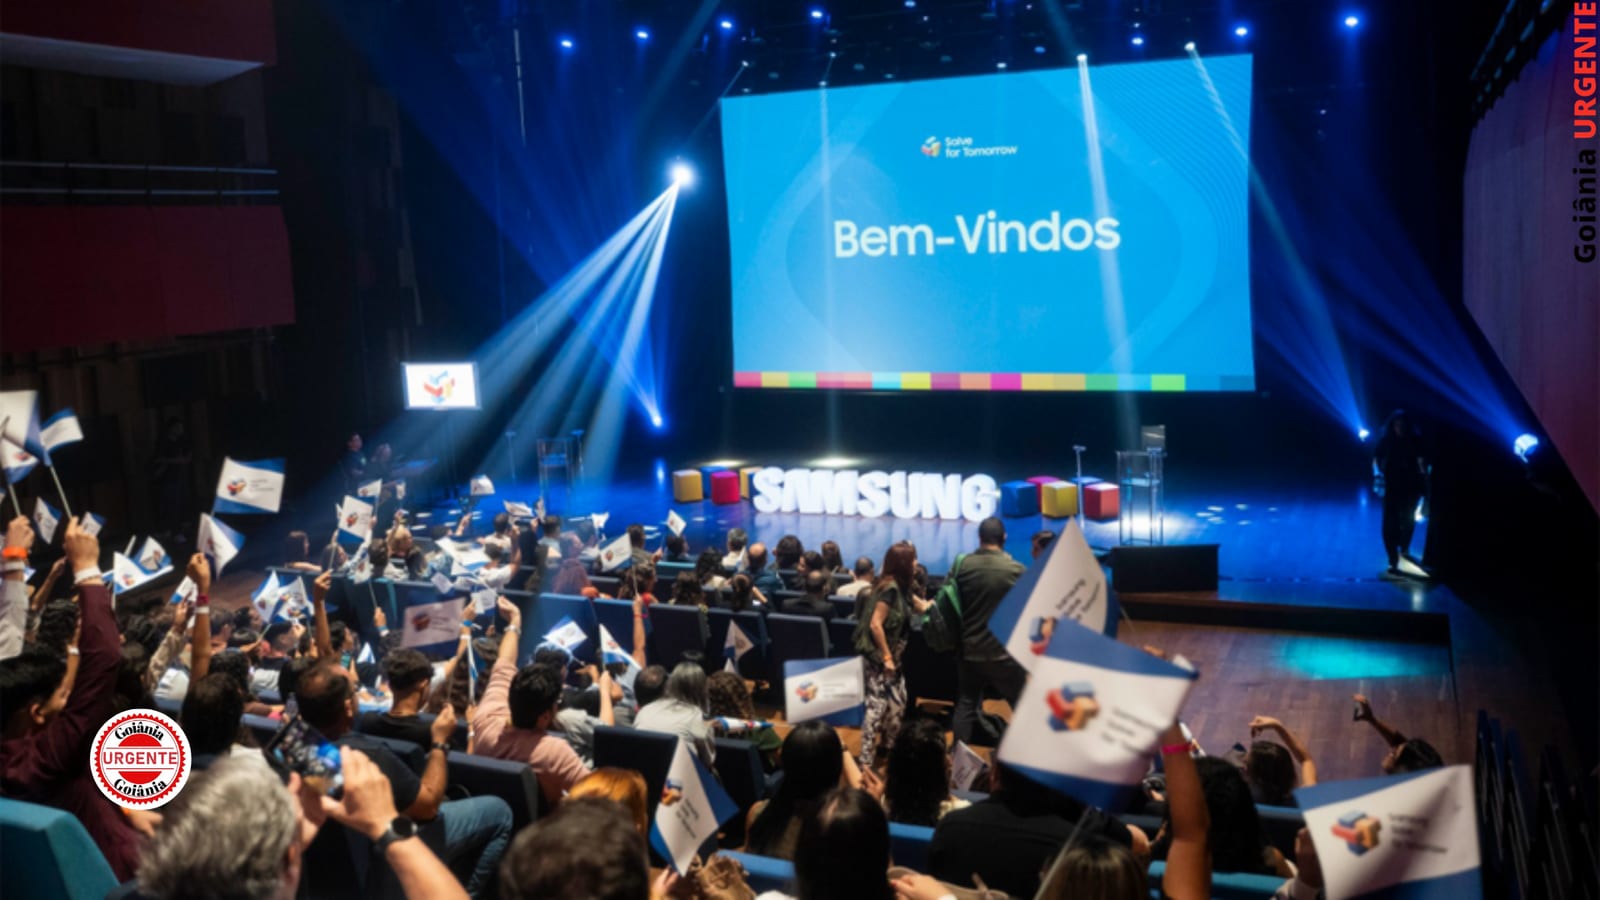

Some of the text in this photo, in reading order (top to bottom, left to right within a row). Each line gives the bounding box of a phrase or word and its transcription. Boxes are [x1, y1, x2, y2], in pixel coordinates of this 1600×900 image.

[944, 136, 973, 147] Solve
[945, 145, 1018, 159] for Tomorrow
[834, 210, 1121, 258] Bem-Vindos
[752, 466, 998, 522] SAMSUNG
